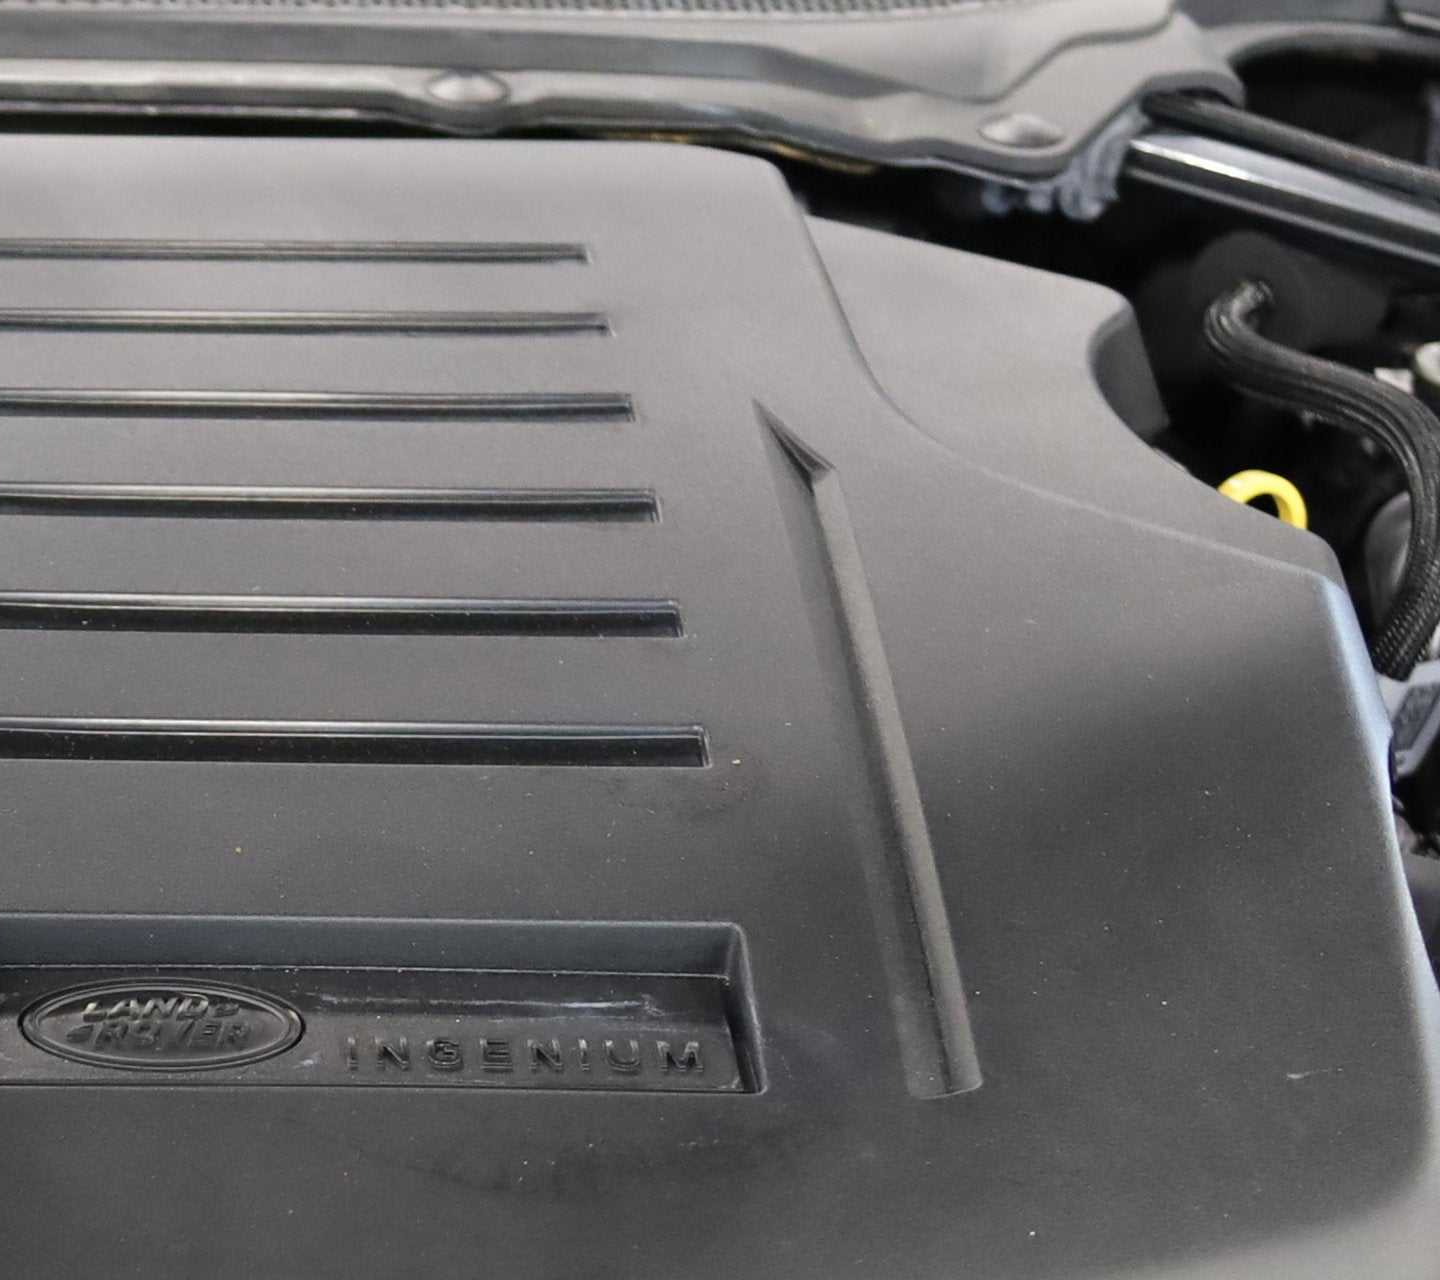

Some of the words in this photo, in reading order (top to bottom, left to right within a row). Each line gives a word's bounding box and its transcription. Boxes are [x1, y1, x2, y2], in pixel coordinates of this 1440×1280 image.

[82, 991, 210, 1022] LAND
[93, 1019, 251, 1051] ROVER
[343, 1035, 705, 1074] INGENIUM
